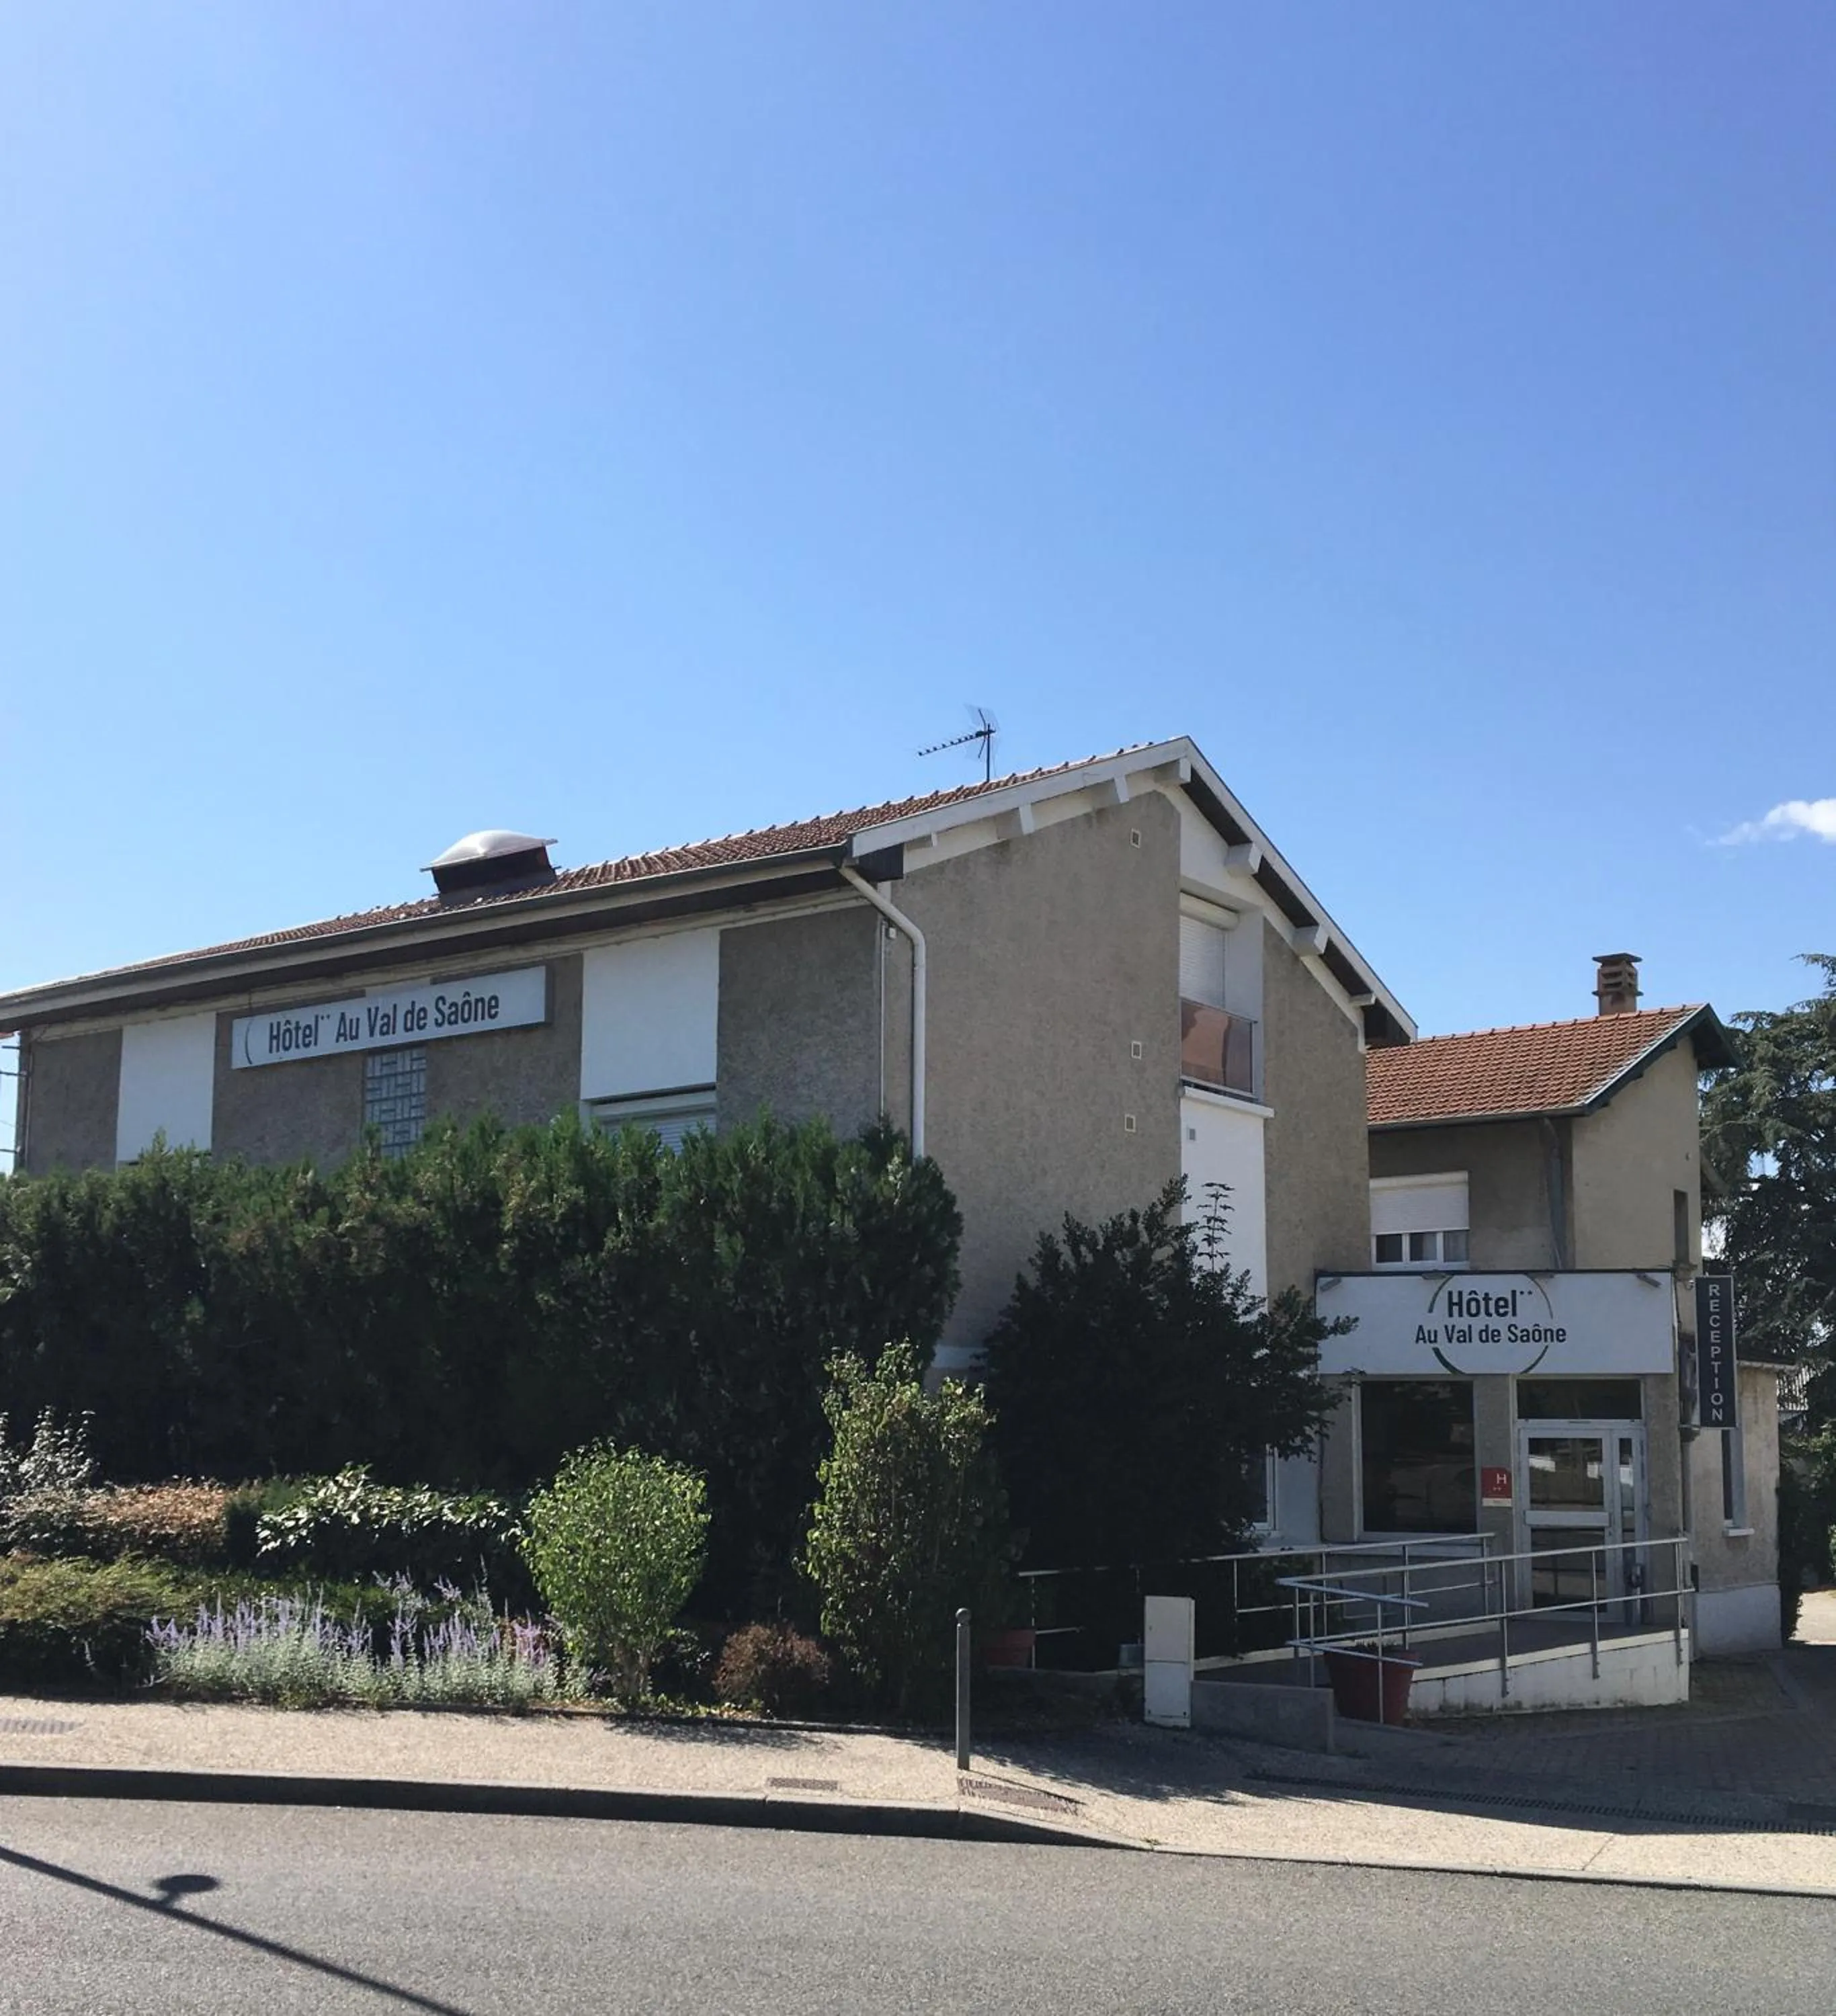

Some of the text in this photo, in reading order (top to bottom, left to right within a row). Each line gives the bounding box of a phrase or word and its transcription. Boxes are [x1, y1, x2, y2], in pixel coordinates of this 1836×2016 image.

[269, 991, 499, 1054] Hôtel Au Val de Saône
[1448, 1290, 1517, 1318] Hôtel
[1415, 1323, 1567, 1344] Au Val de Saône
[1709, 1284, 1723, 1421] RECEPTION
[1497, 1473, 1507, 1484] H
